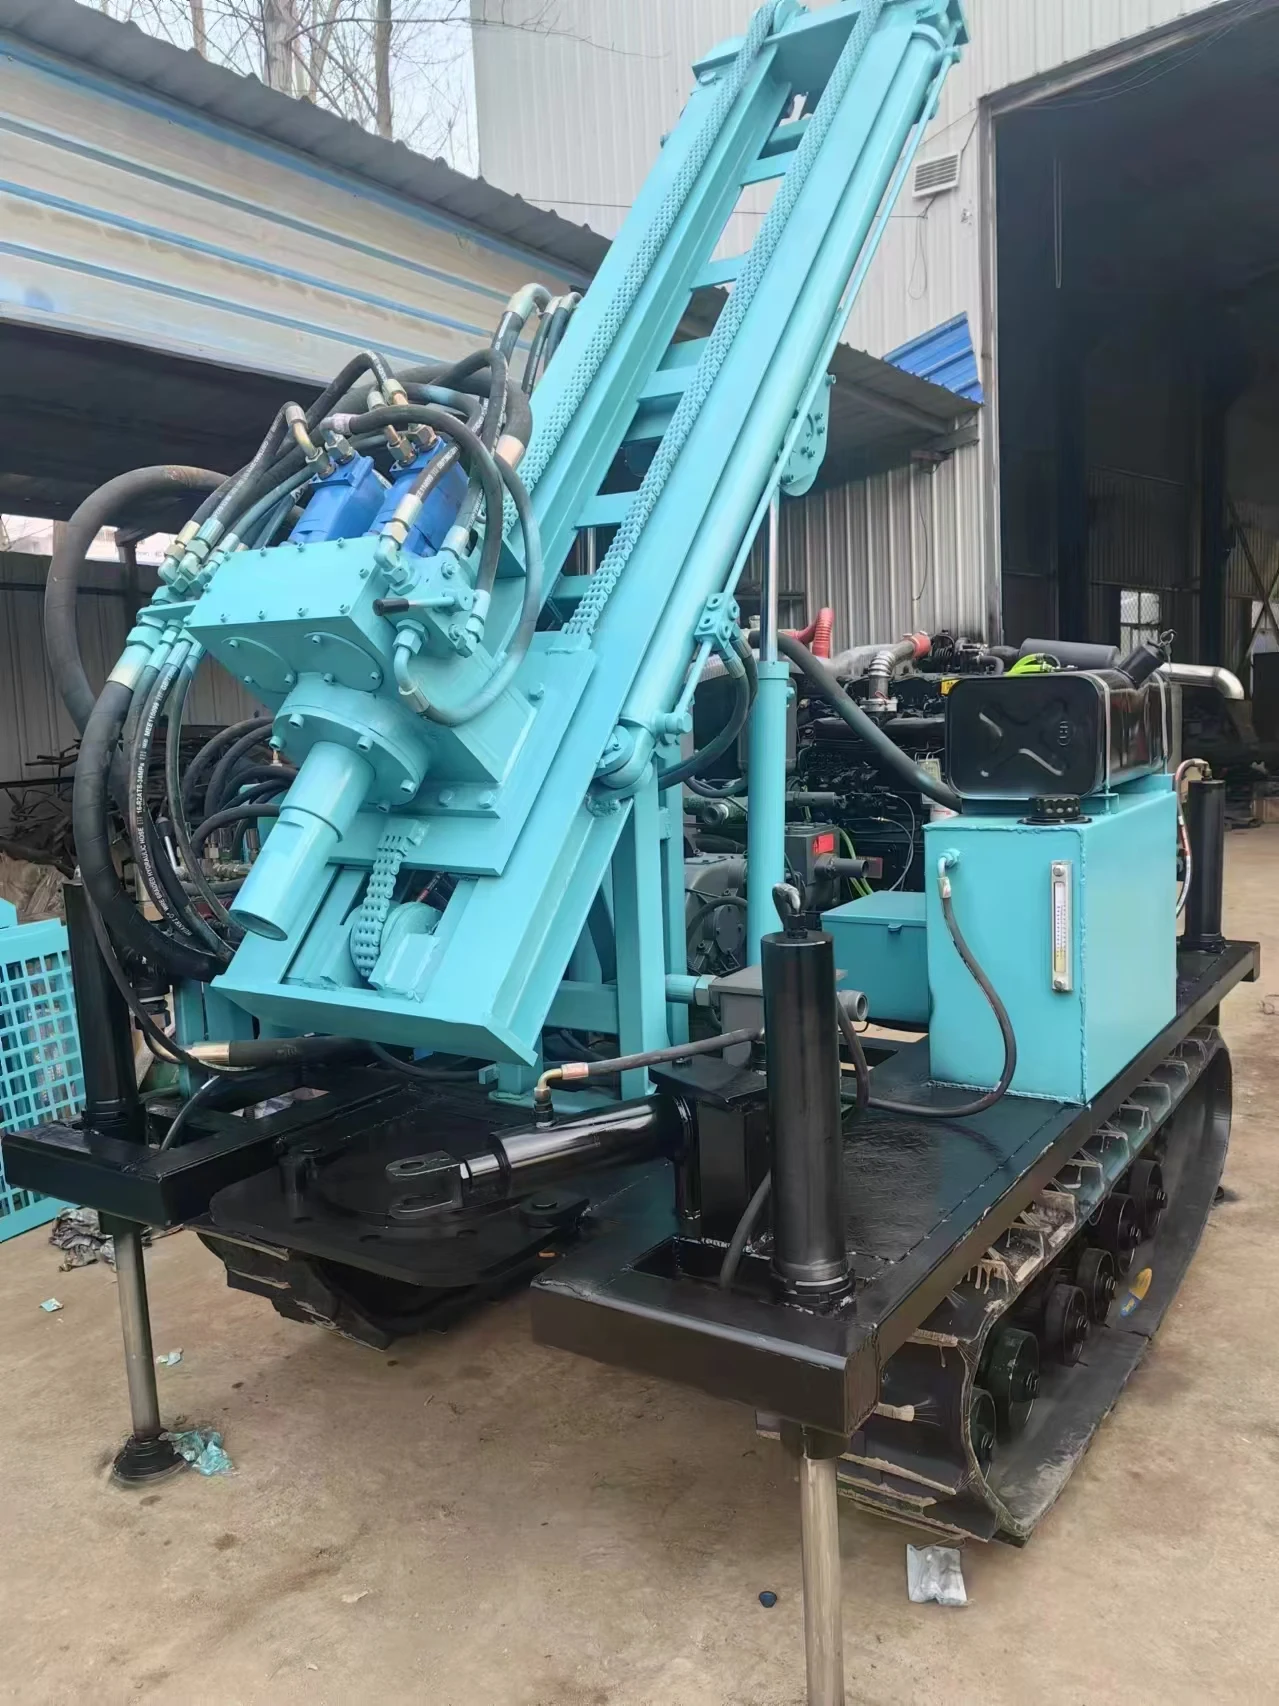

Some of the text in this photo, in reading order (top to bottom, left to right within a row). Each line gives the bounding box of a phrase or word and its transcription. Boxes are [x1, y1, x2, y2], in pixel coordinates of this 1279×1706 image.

[137, 827, 145, 844] HOSE
[140, 844, 153, 877] HYDRAULIC
[149, 877, 163, 900] BRAIDED
[159, 899, 169, 912] WIRE
